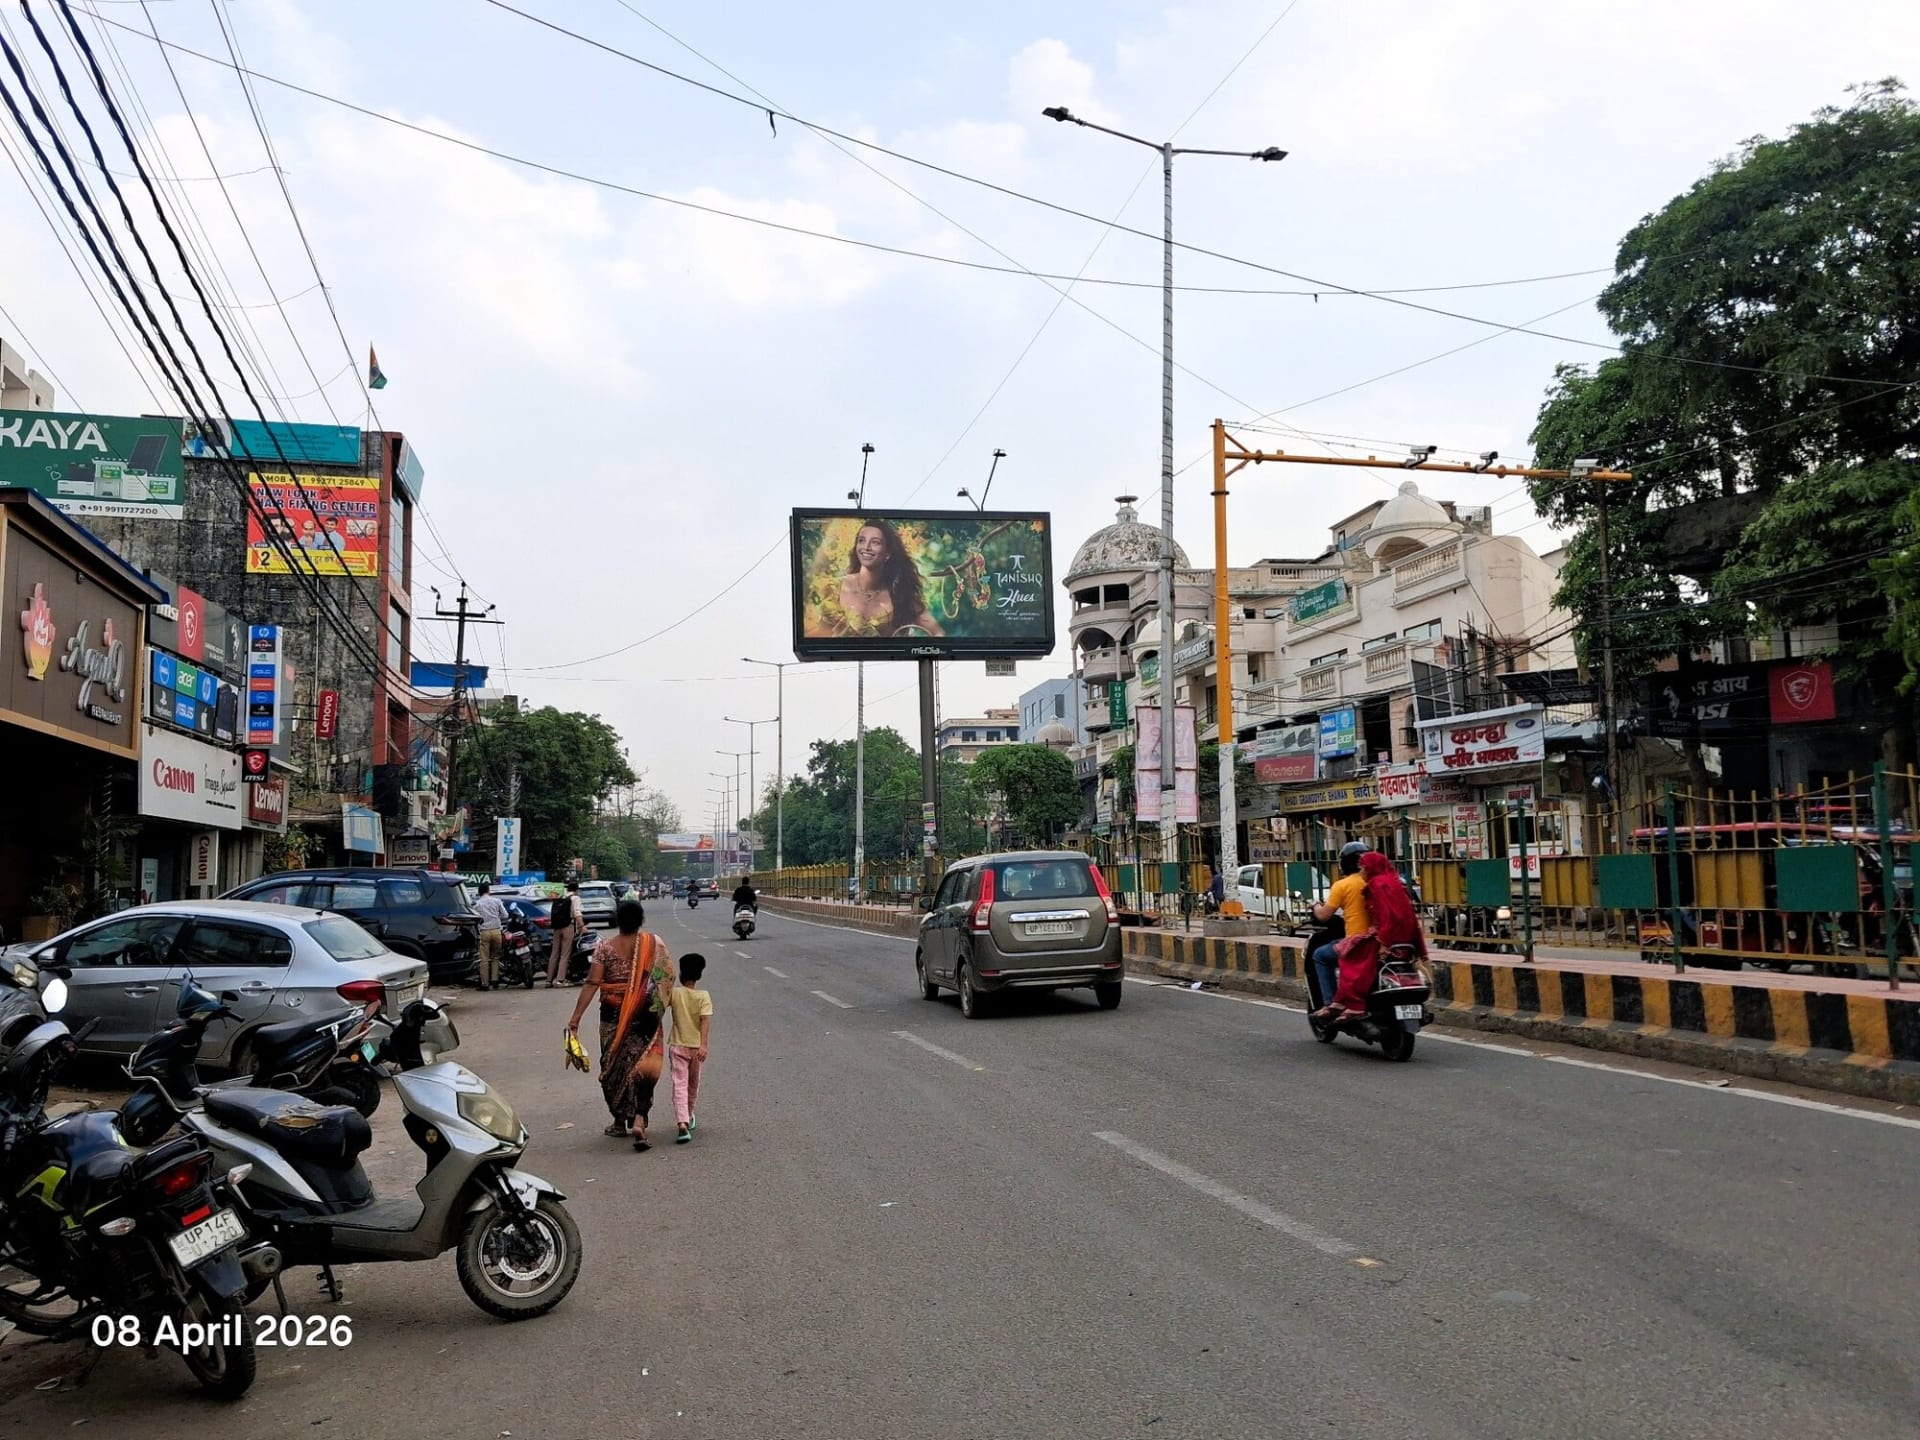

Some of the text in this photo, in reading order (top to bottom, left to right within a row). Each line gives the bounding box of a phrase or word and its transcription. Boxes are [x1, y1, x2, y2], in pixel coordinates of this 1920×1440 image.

[256, 487, 282, 496] NW
[257, 498, 284, 508] HAR
[289, 500, 327, 511] FIXNG
[996, 588, 1036, 608] Hues
[178, 671, 195, 688] acer
[1114, 686, 1122, 716] HOTEL
[252, 718, 270, 727] intel
[320, 694, 333, 733] Lenovo
[1338, 734, 1353, 744] acer
[1449, 721, 1507, 744] कान्हा
[1442, 747, 1475, 767] पनीर
[153, 758, 195, 794] Canon
[1262, 763, 1306, 777] Pioneer
[198, 835, 210, 880] Canon
[394, 854, 428, 862] Lenovo
